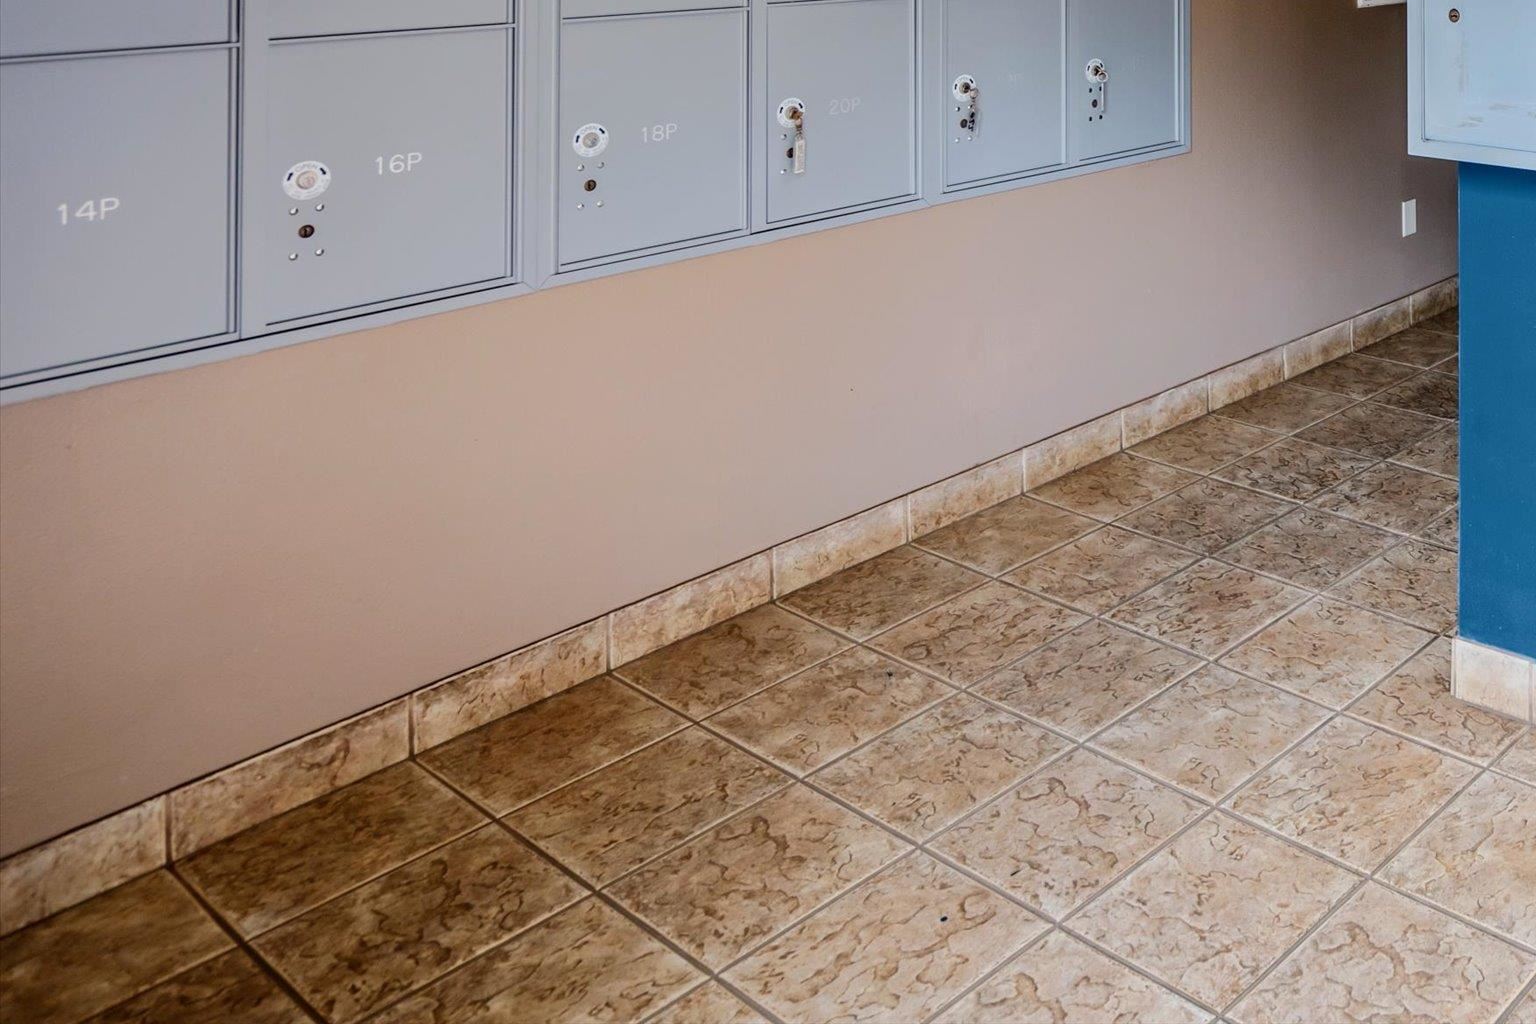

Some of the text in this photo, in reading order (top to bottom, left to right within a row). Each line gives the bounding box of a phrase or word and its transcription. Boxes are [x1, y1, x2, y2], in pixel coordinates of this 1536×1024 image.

[642, 123, 678, 143] 18P
[375, 152, 422, 176] 16P
[57, 197, 120, 225] 14P
